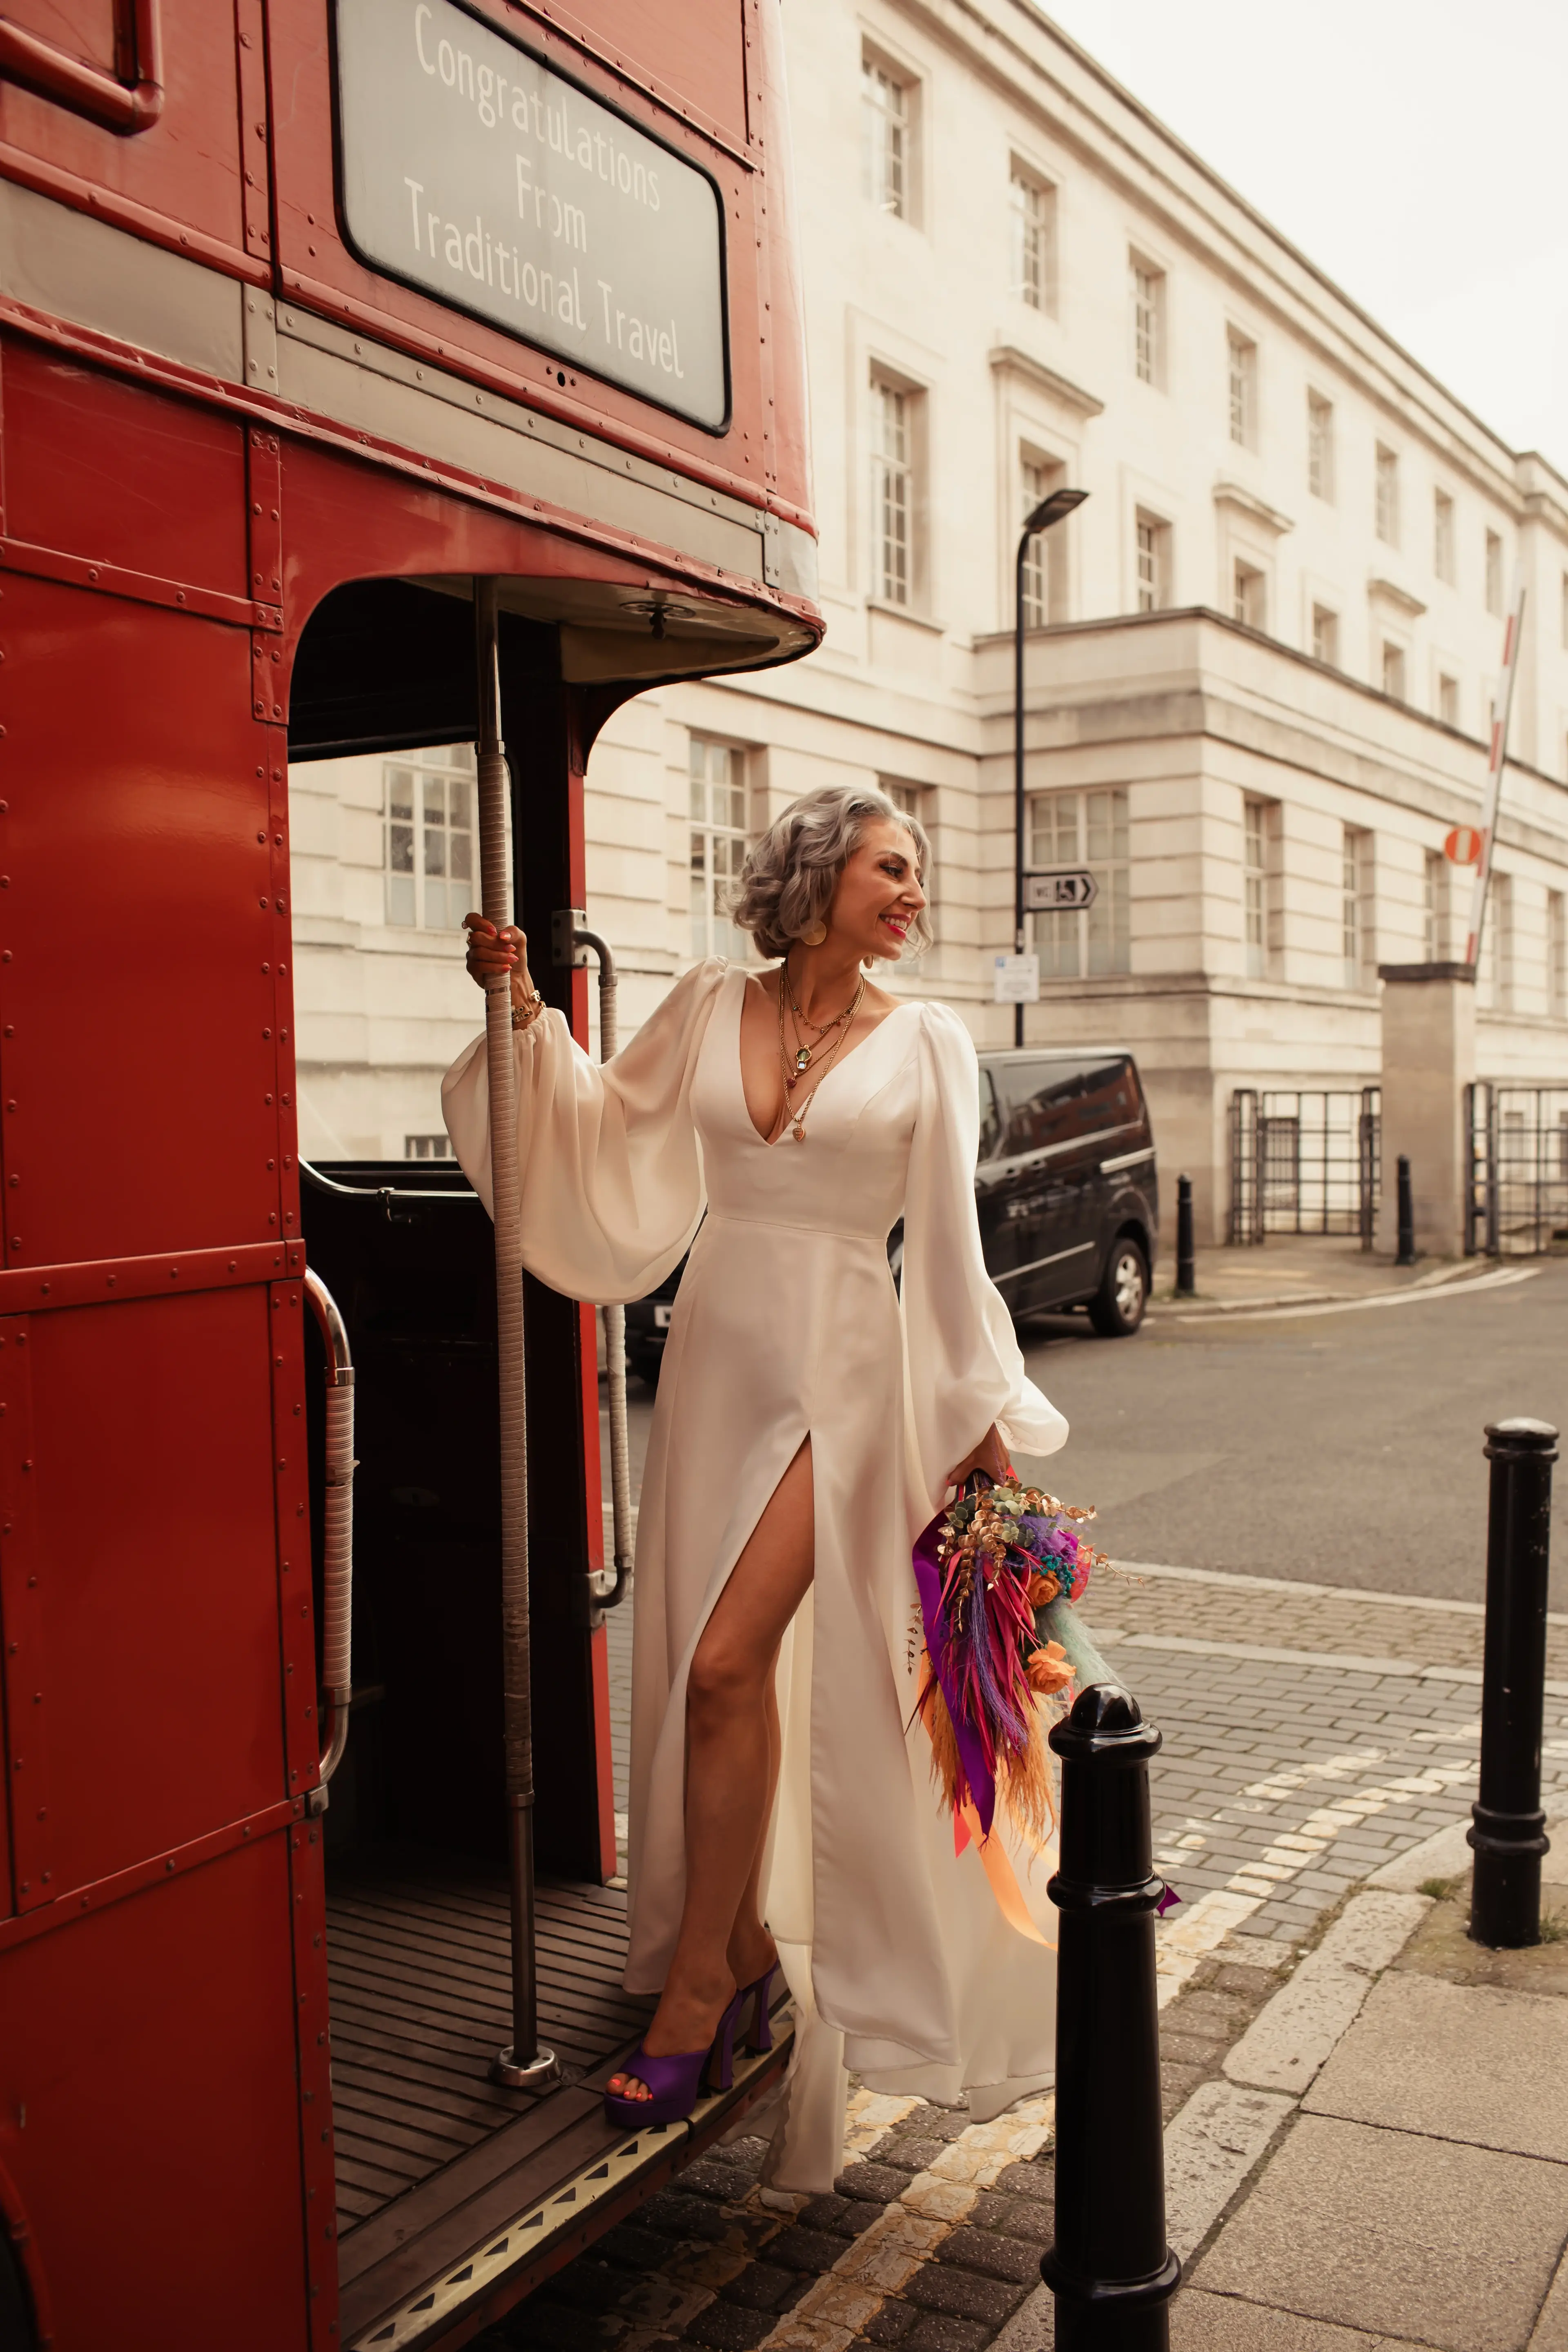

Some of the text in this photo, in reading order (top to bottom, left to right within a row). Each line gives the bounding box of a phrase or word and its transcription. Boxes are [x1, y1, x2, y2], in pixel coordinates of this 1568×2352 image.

[415, 4, 660, 211] Congratulations
[405, 177, 684, 379] Traditional Travel
